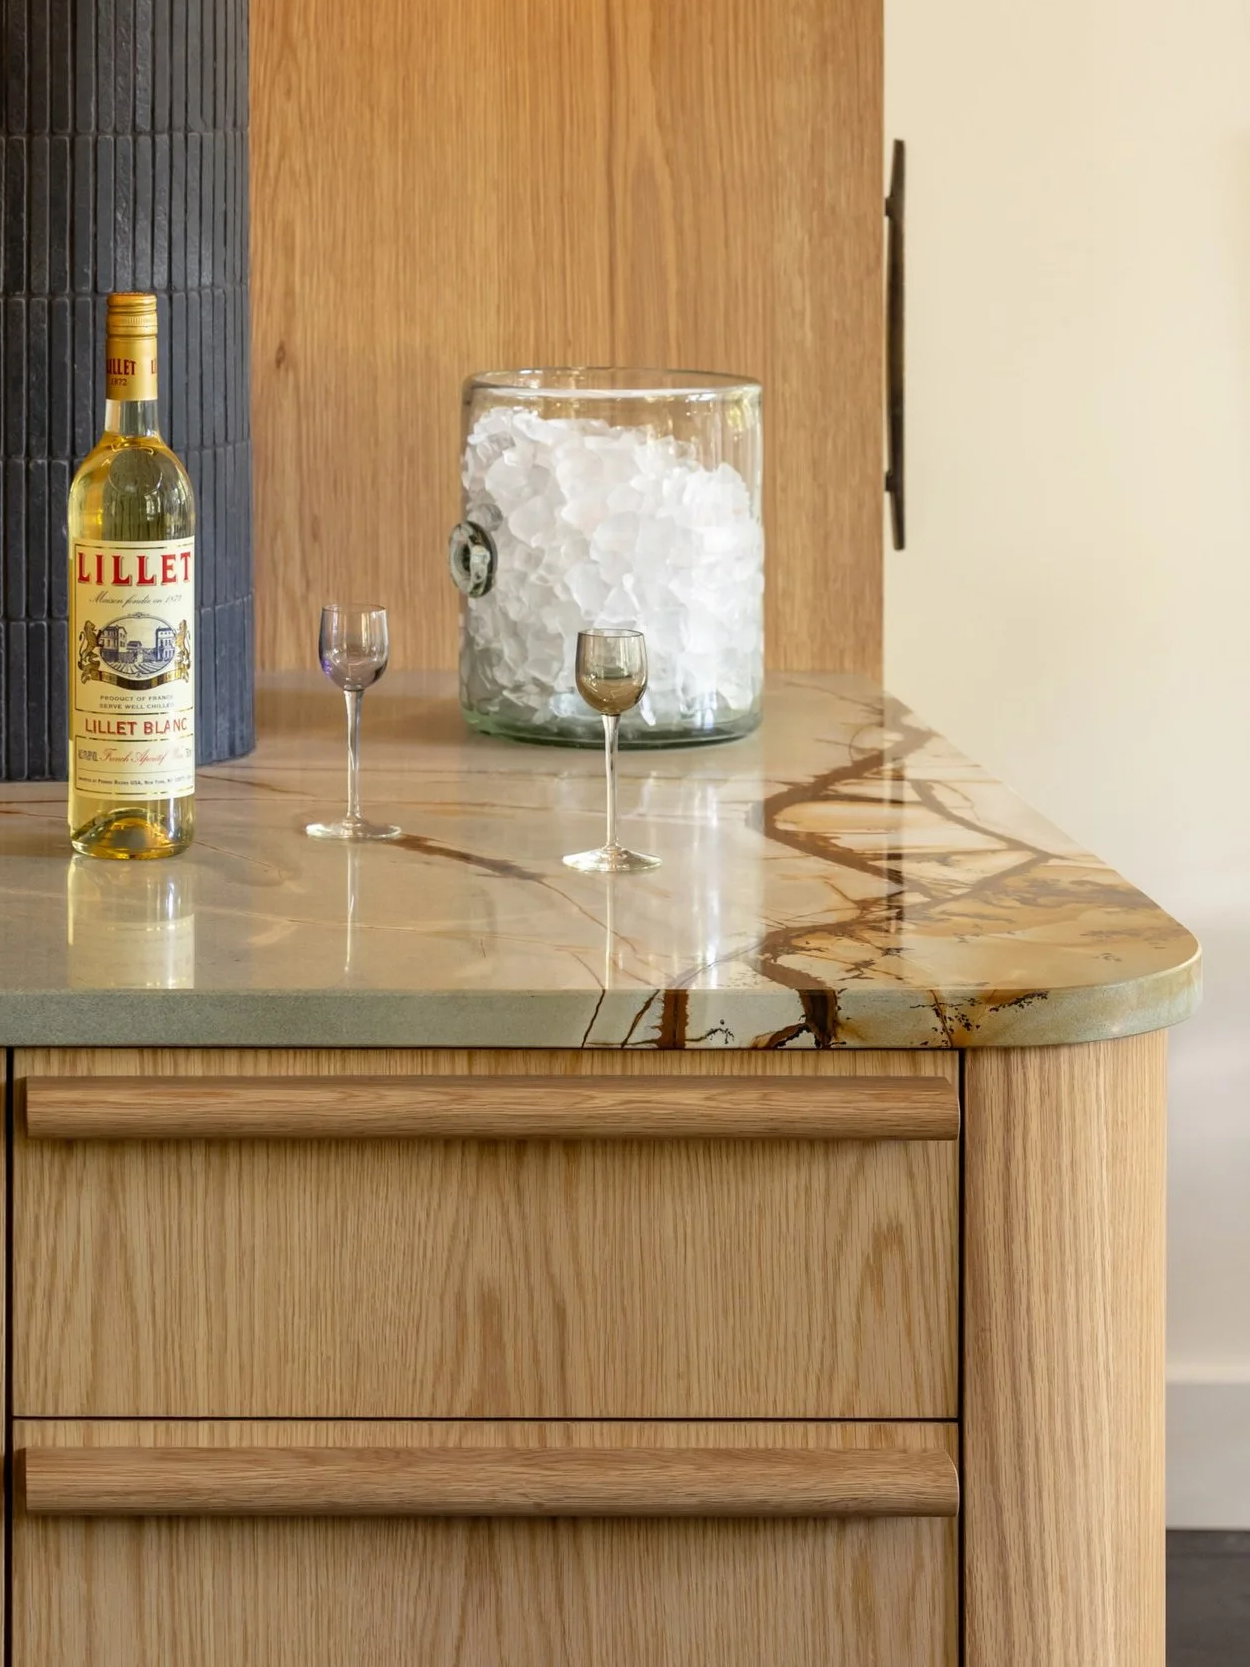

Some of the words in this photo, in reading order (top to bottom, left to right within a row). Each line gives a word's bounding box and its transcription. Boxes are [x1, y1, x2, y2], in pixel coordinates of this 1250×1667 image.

[78, 551, 191, 586] LILLET
[85, 718, 137, 736] LILLET
[143, 718, 188, 735] BLANC
